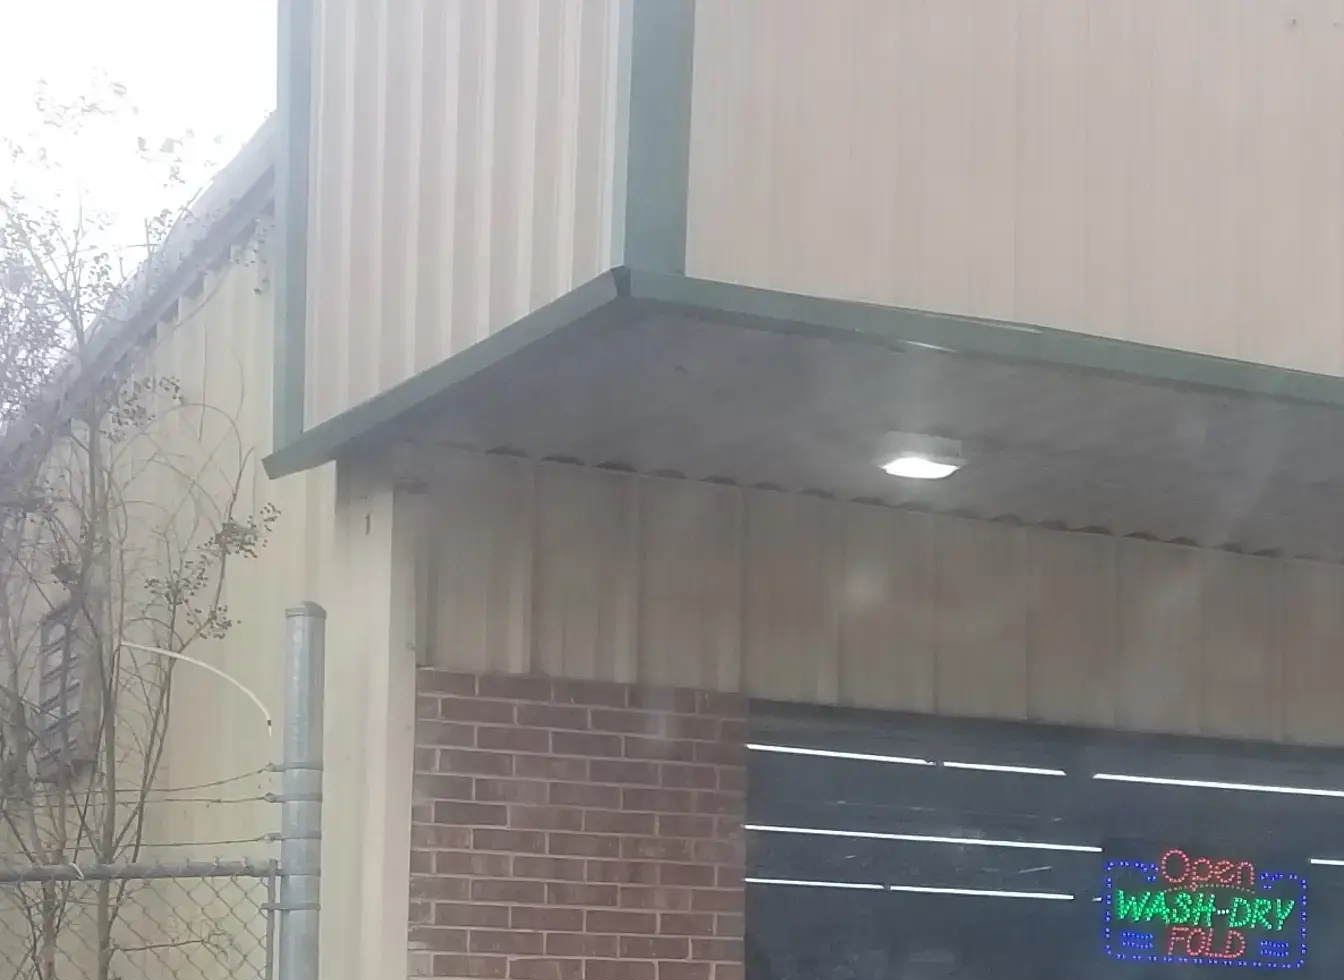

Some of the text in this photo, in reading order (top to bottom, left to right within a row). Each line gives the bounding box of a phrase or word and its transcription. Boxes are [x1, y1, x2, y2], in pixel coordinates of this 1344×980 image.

[1160, 848, 1256, 892] Open
[1114, 888, 1295, 931] WASH-DRY
[1166, 926, 1247, 959] FOLD
